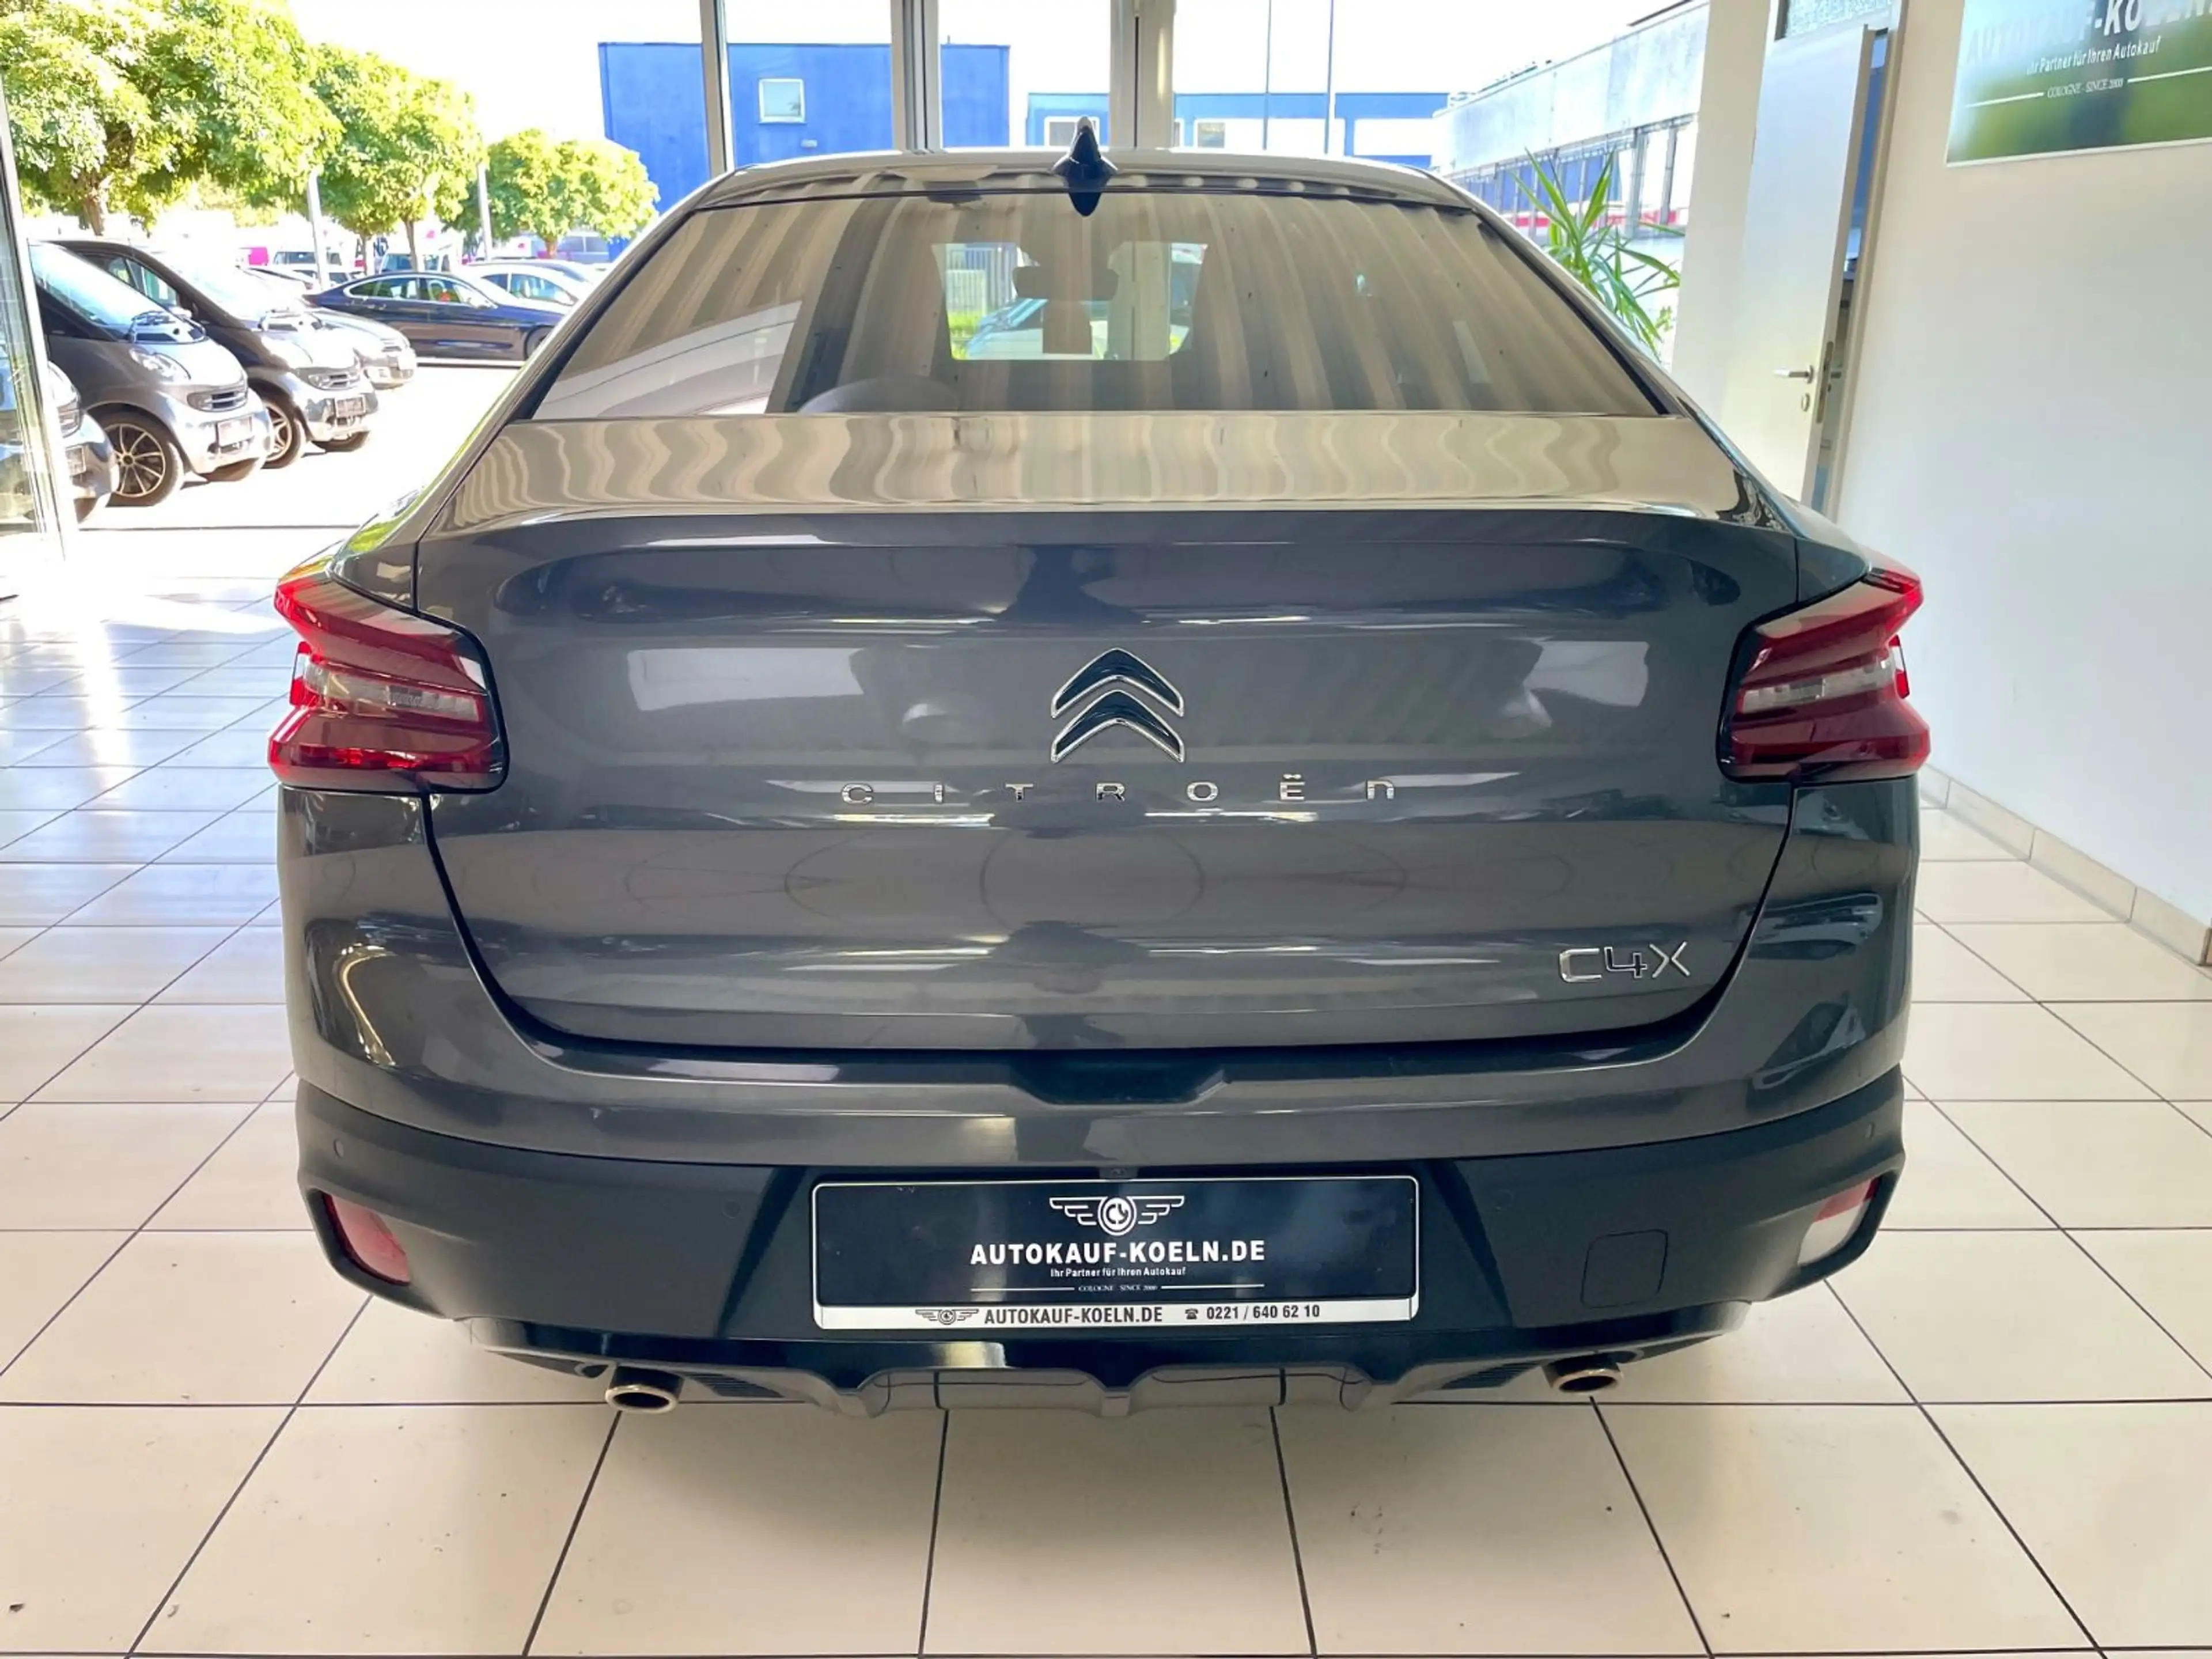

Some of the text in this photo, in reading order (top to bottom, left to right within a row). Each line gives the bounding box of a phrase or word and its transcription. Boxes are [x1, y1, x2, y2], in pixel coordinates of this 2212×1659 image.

[2040, 56, 2072, 73] Partner
[2112, 35, 2161, 60] Autokauf
[970, 1240, 1266, 1265] AUTOKAUF-KOELN.DE
[1050, 1269, 1064, 1277] Ihr
[1066, 1268, 1100, 1277] Partner
[1103, 1267, 1116, 1277] für
[1143, 1267, 1187, 1276] Autokauf
[984, 1306, 1162, 1324] AUTOKAUF-KOELN.DE
[1206, 1306, 1238, 1320] 0221
[1253, 1305, 1278, 1319] 640
[1282, 1305, 1299, 1319] 62
[1304, 1304, 1320, 1317] 10
